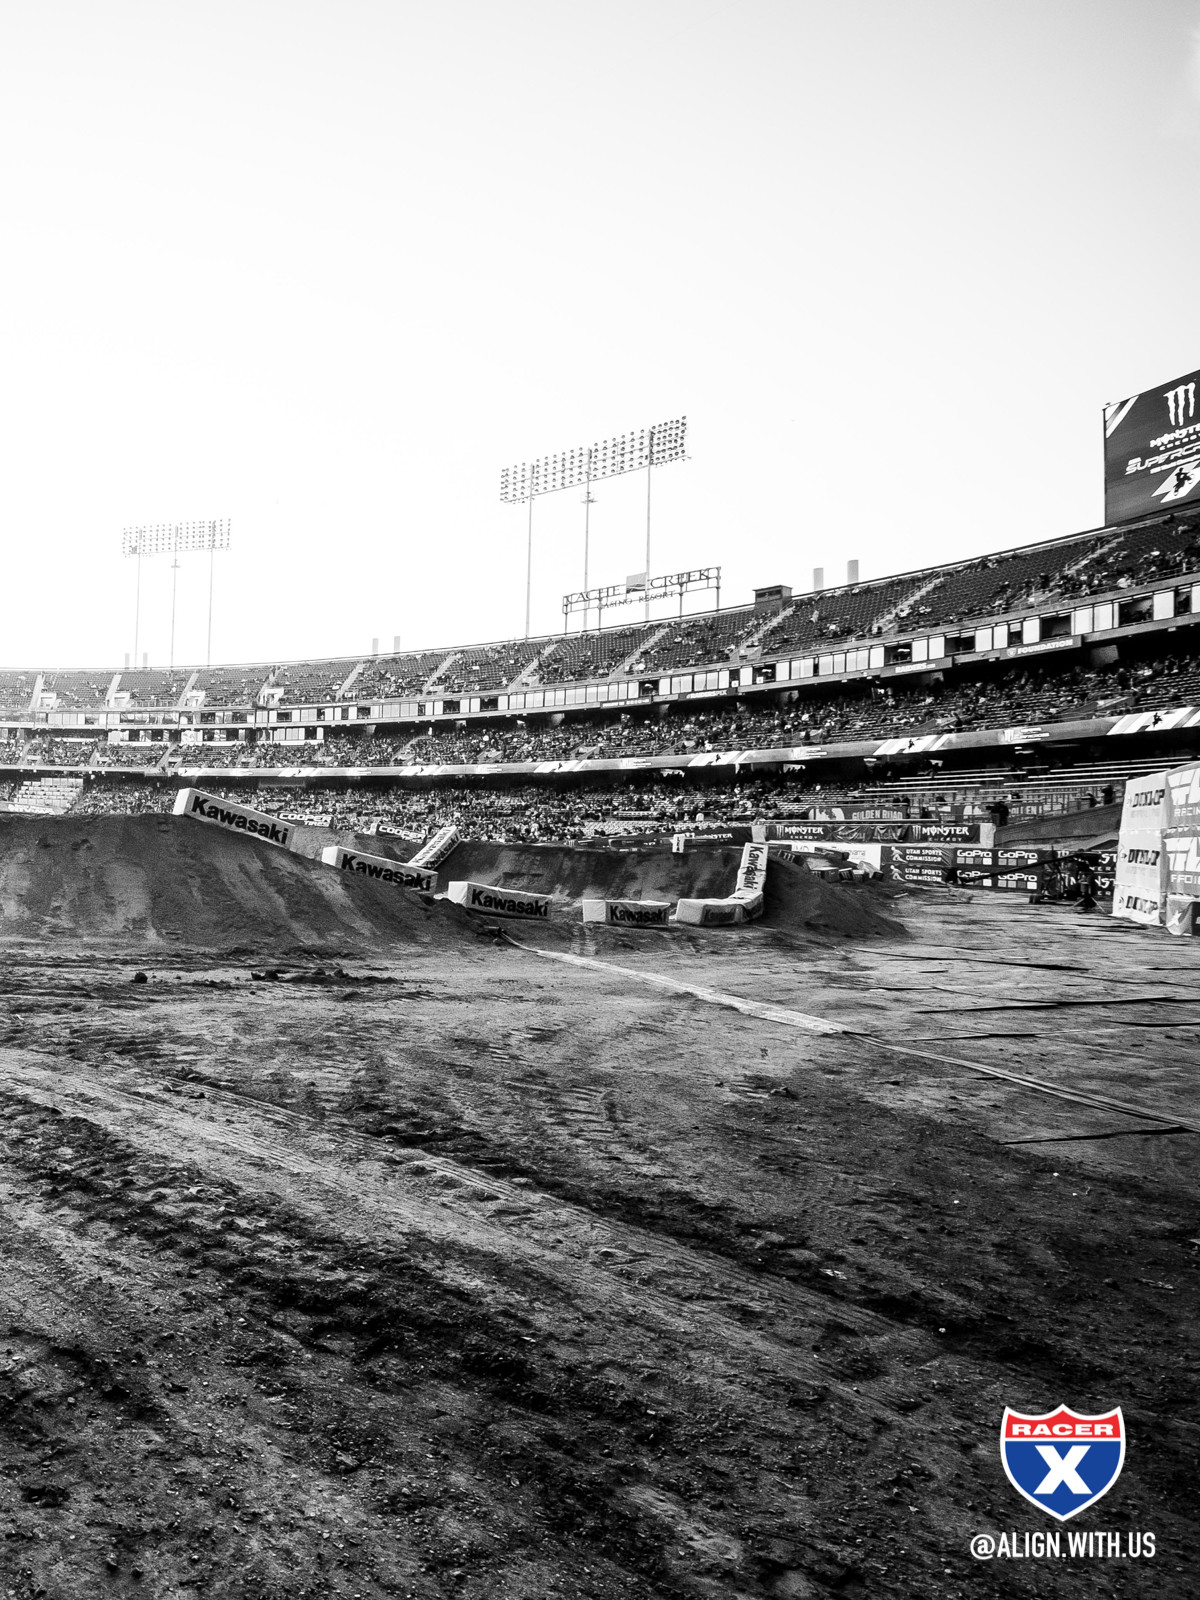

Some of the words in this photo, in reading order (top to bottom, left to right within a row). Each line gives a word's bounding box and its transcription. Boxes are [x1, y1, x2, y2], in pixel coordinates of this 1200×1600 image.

[650, 569, 711, 589] CREEK
[1017, 639, 1074, 655] FOUNDATION
[191, 795, 290, 846] Kawasaki
[278, 812, 333, 823] COOPER
[378, 824, 426, 840] COOPER
[784, 826, 824, 836] MONSTER
[922, 825, 969, 837] MONSTER
[905, 855, 942, 863] COMMISSION
[956, 849, 993, 858] GoPro
[998, 850, 1039, 859] GoPro
[341, 853, 432, 892] Kawasaki
[742, 844, 765, 890] Kawasaki
[905, 867, 919, 876] UTAH
[920, 868, 943, 876] SPORTS
[904, 874, 942, 882] COMMISSION
[472, 888, 549, 918] Kawasaki
[609, 905, 668, 923] Kawasaki
